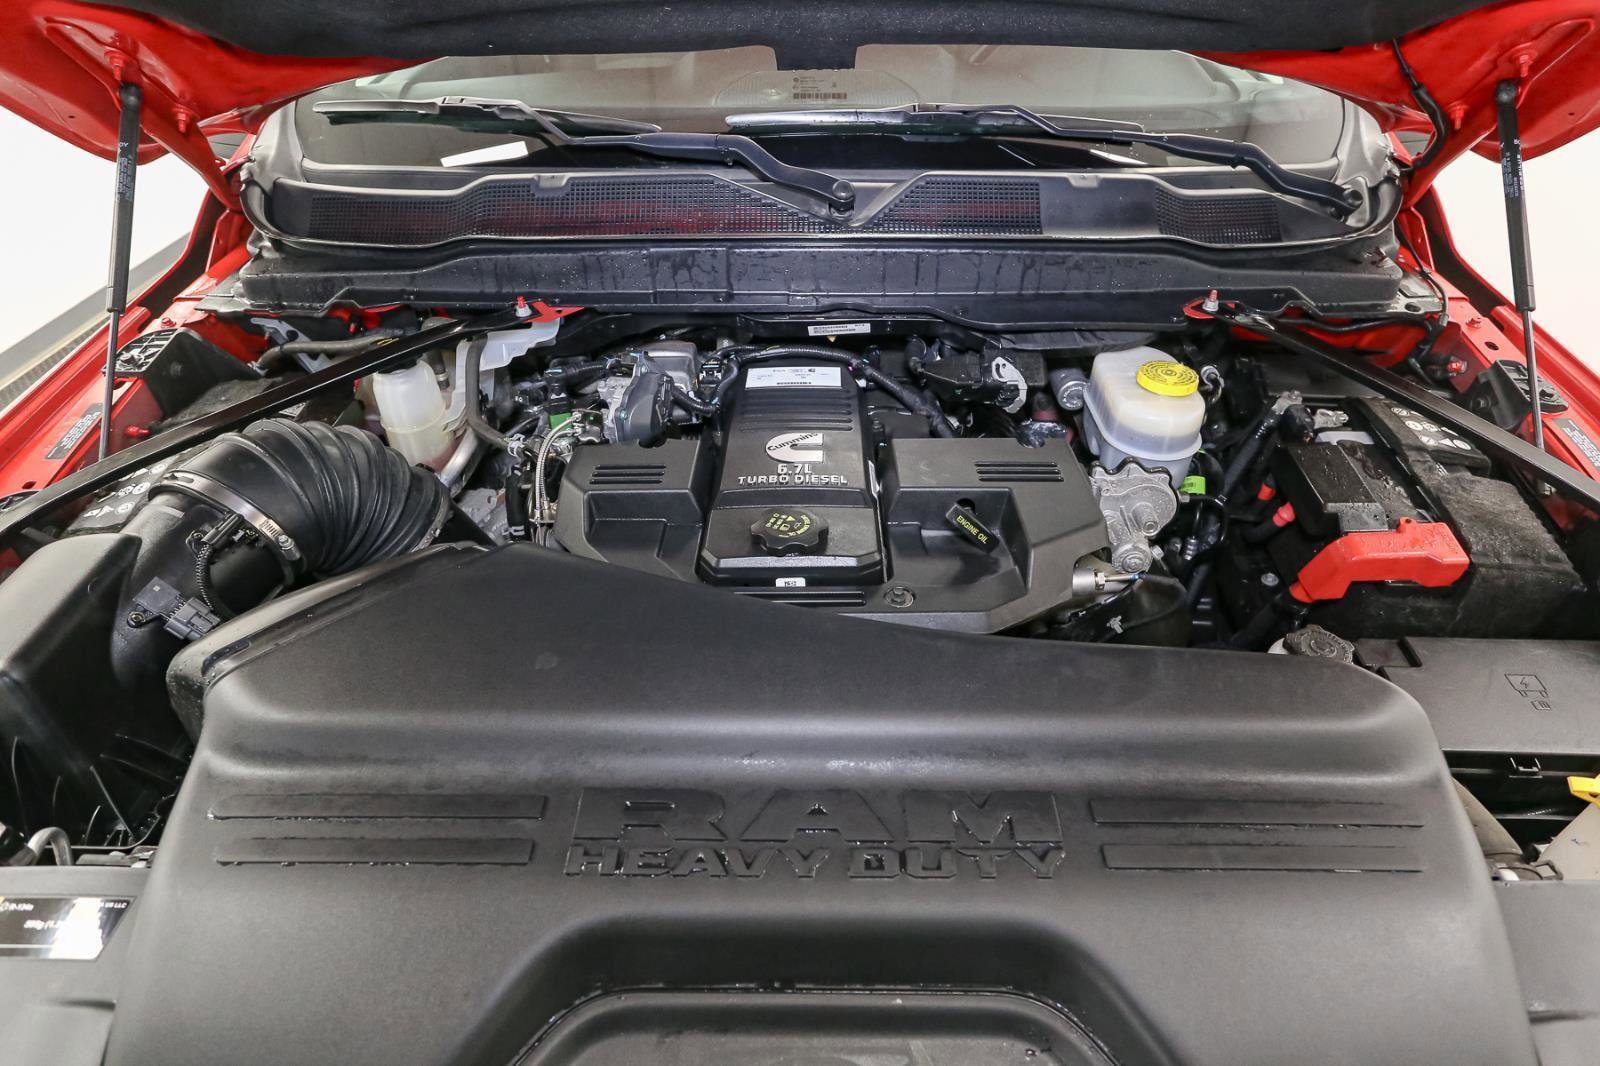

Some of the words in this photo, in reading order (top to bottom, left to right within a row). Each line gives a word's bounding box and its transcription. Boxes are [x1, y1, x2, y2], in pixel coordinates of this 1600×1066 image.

[738, 474, 790, 486] TURBO
[794, 474, 848, 486] DIESEL
[777, 463, 813, 474] 6.7L
[956, 515, 979, 536] ENGINE
[977, 533, 988, 544] OIL
[572, 788, 1063, 842] RAM
[563, 845, 830, 878] HEAVY
[849, 846, 1066, 879] DUTY
